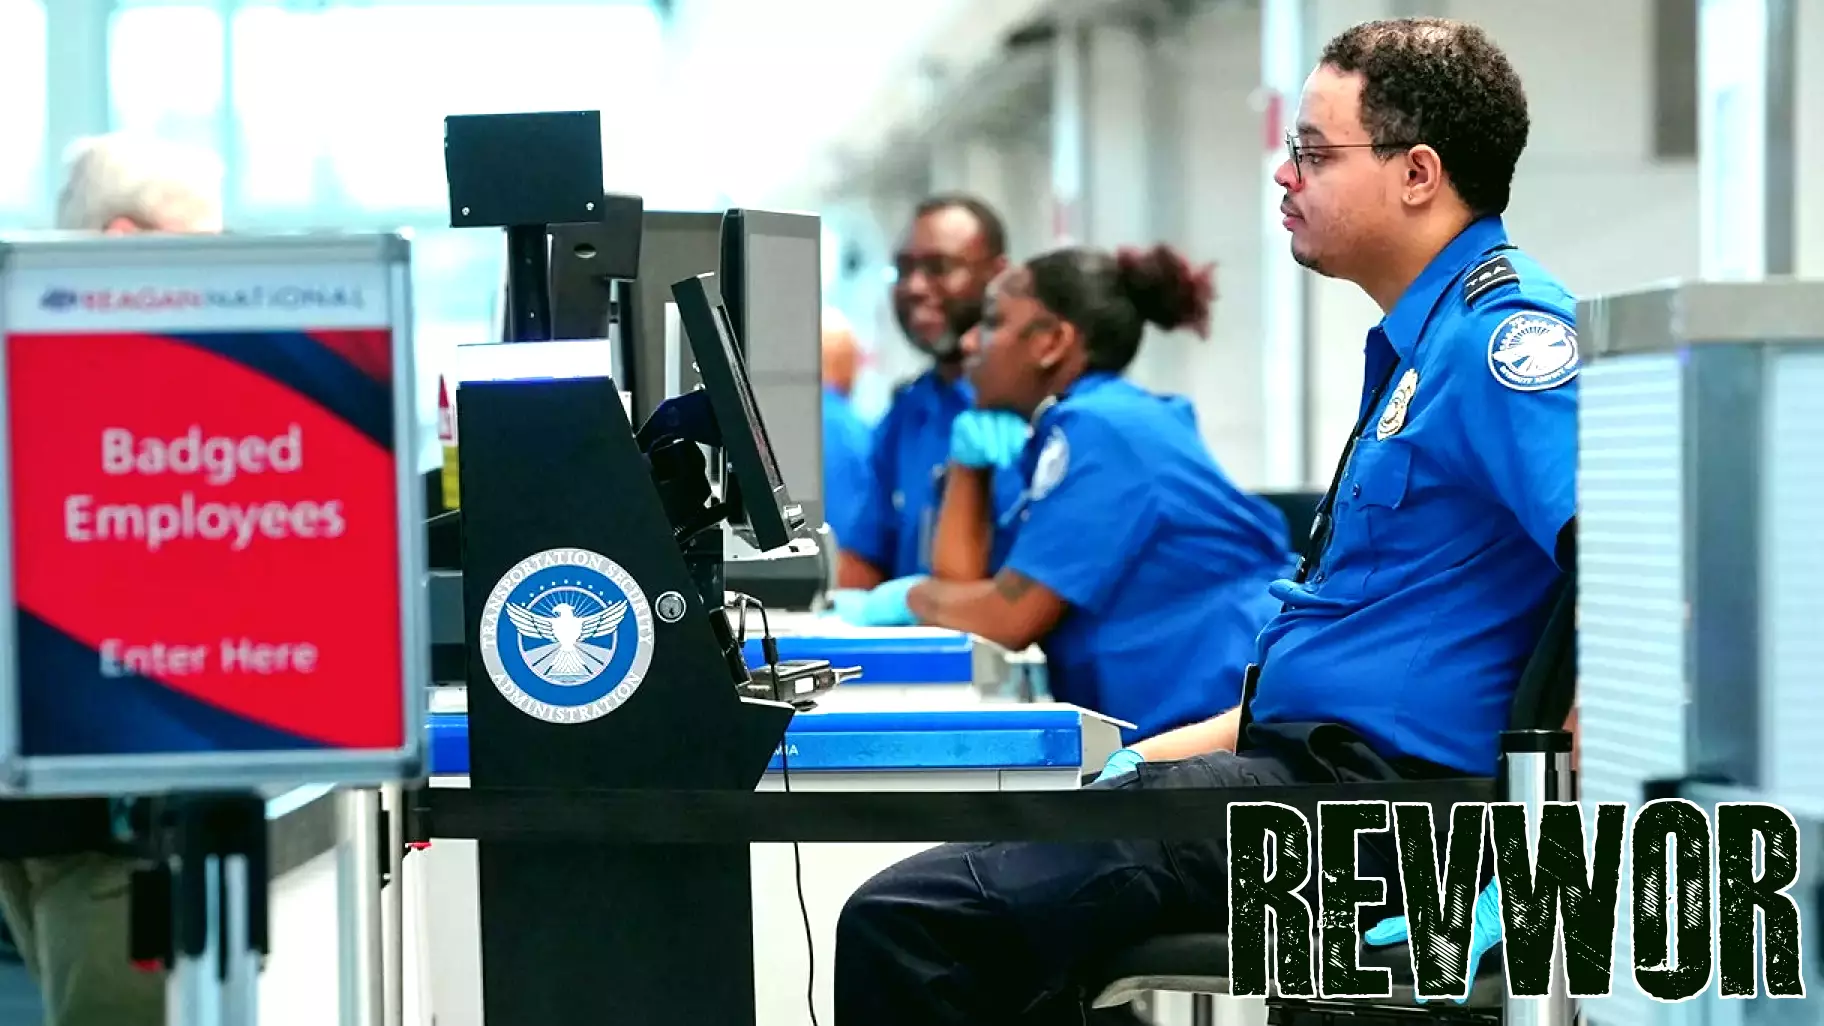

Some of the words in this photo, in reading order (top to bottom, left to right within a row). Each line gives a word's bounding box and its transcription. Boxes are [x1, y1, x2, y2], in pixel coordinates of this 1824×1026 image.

[101, 423, 304, 486] Badged
[63, 490, 346, 553] Employees
[482, 551, 602, 649] TRANSPORTATION
[605, 564, 652, 645] SECURITY
[98, 638, 208, 678] Enter
[219, 637, 319, 674] Here
[494, 672, 642, 722] ADMINISTRATION
